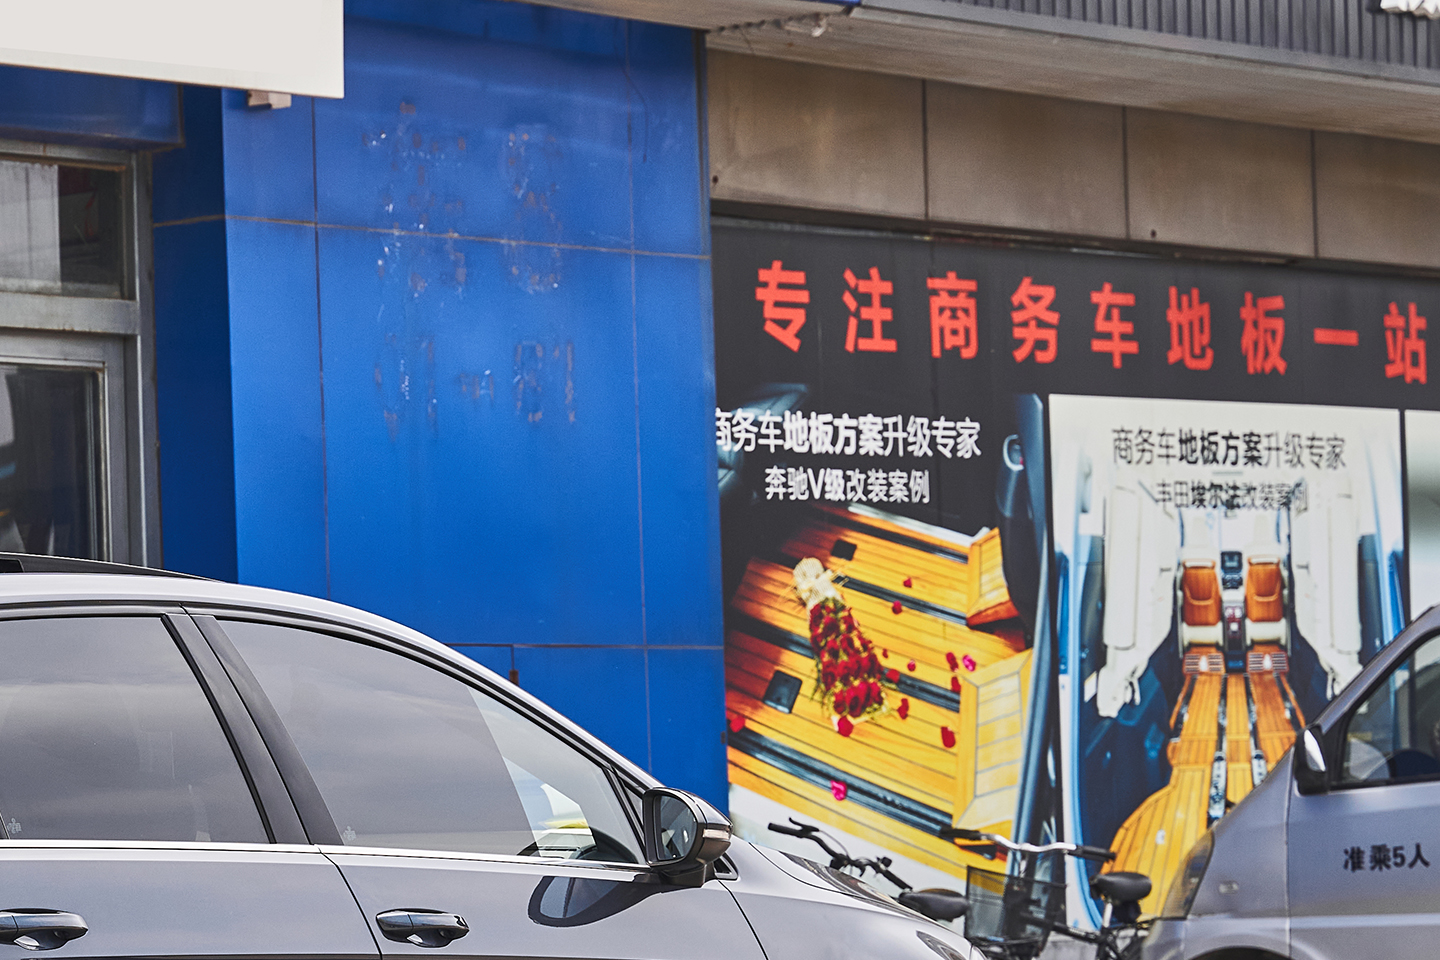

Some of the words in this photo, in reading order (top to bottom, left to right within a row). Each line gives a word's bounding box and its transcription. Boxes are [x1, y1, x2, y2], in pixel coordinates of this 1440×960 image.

[755, 259, 1428, 385] 专注商务车地板一站
[1112, 426, 1346, 469] 商务车地板方案升级专家
[764, 465, 930, 504] 奔驰V级改装案例
[1343, 842, 1431, 873] 准乘5人
